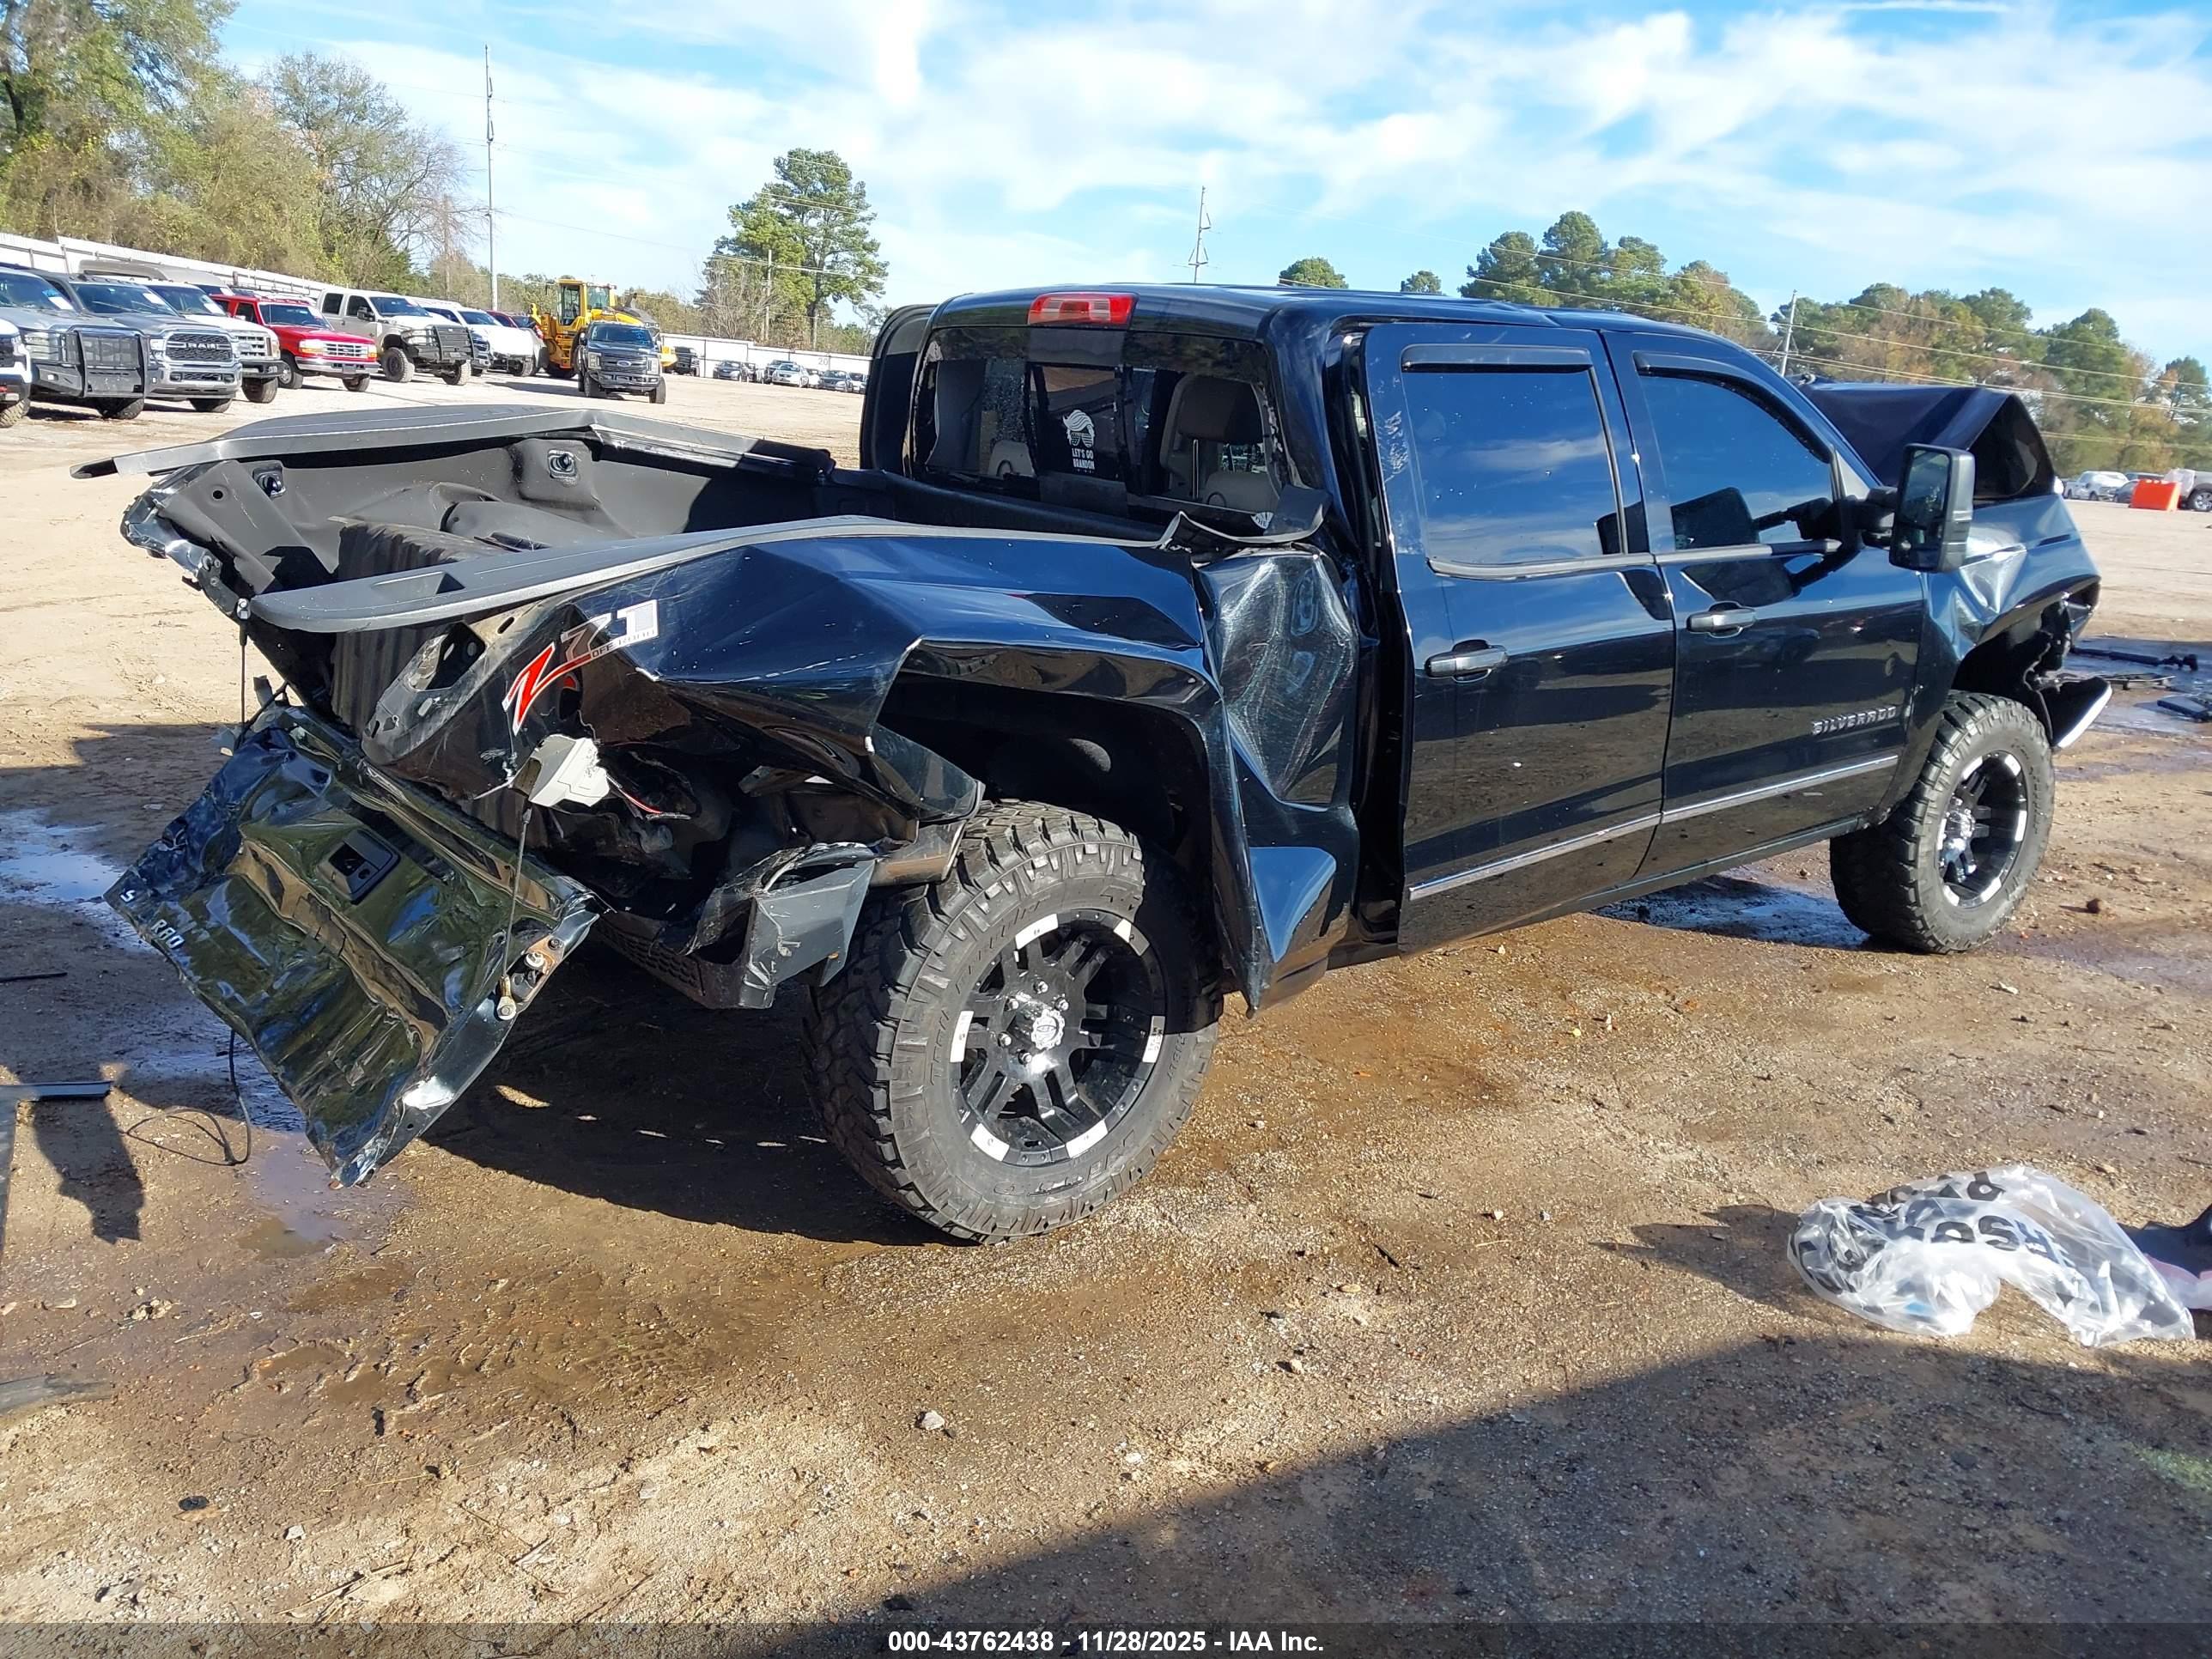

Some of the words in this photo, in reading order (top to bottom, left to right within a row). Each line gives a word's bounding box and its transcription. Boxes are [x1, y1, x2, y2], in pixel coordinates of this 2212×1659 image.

[1072, 447, 1085, 459] LET'S
[1085, 449, 1095, 460] GO
[592, 641, 615, 659] OFF
[1812, 706, 1896, 736] SILVERADO
